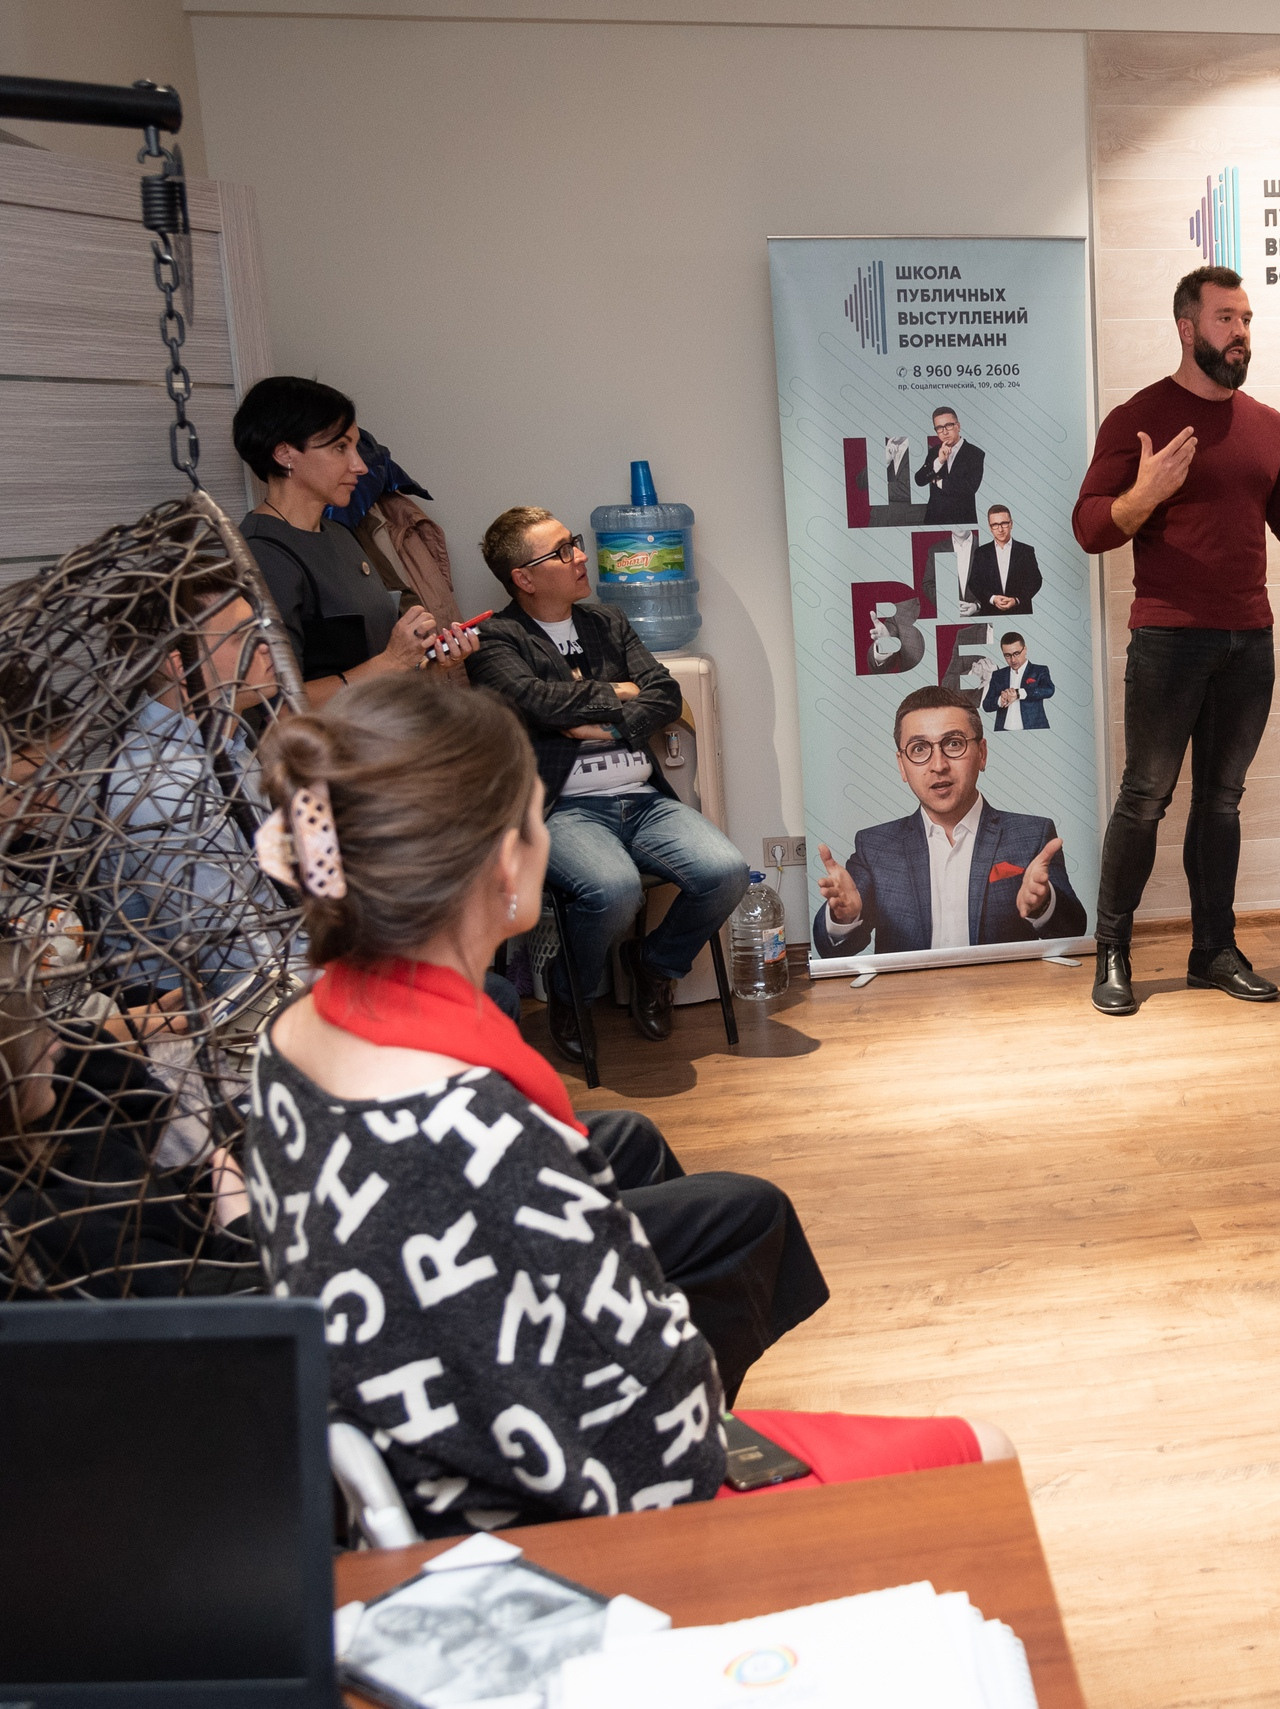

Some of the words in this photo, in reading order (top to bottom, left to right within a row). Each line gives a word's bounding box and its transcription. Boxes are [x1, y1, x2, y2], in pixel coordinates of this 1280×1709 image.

[895, 266, 961, 280] ШКОЛА
[896, 288, 1006, 303] ПУБЛИЧНЫХ
[898, 307, 1028, 325] ВЫСТУПЛЕНИЙ
[899, 333, 1007, 348] БОРНЕМАНН
[913, 365, 922, 378] 8
[926, 364, 952, 378] 960
[956, 364, 982, 377] 946
[986, 363, 1020, 376] 2606
[898, 383, 909, 391] пр.
[978, 381, 992, 389] 109,
[993, 381, 1007, 390] оф.
[1007, 380, 1021, 388] 204
